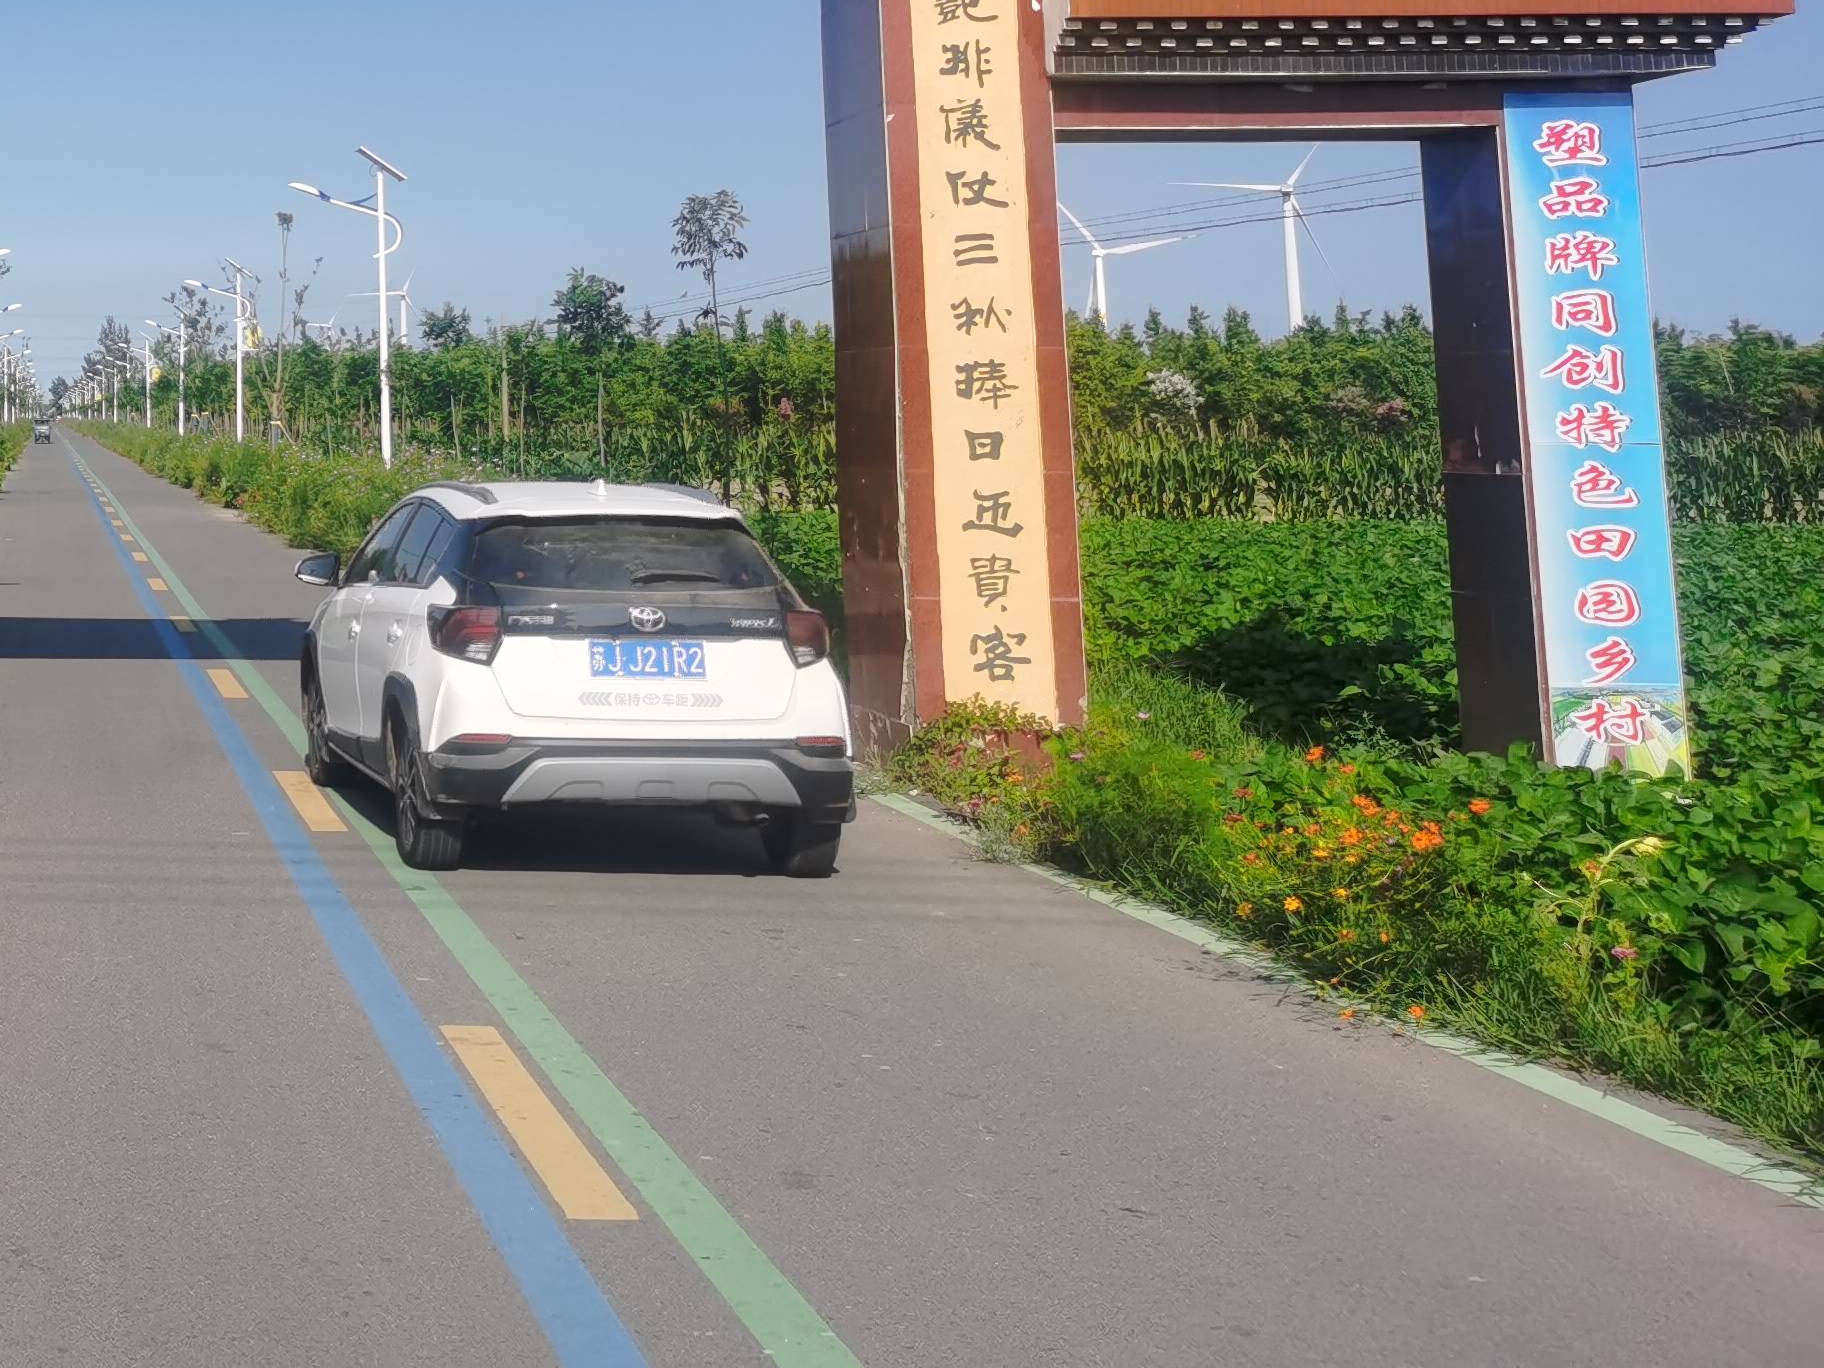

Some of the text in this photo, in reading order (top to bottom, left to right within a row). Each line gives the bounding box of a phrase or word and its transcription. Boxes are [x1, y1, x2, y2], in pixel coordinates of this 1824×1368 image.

[1532, 118, 1647, 746] 塑品牌同创特色田园乡村
